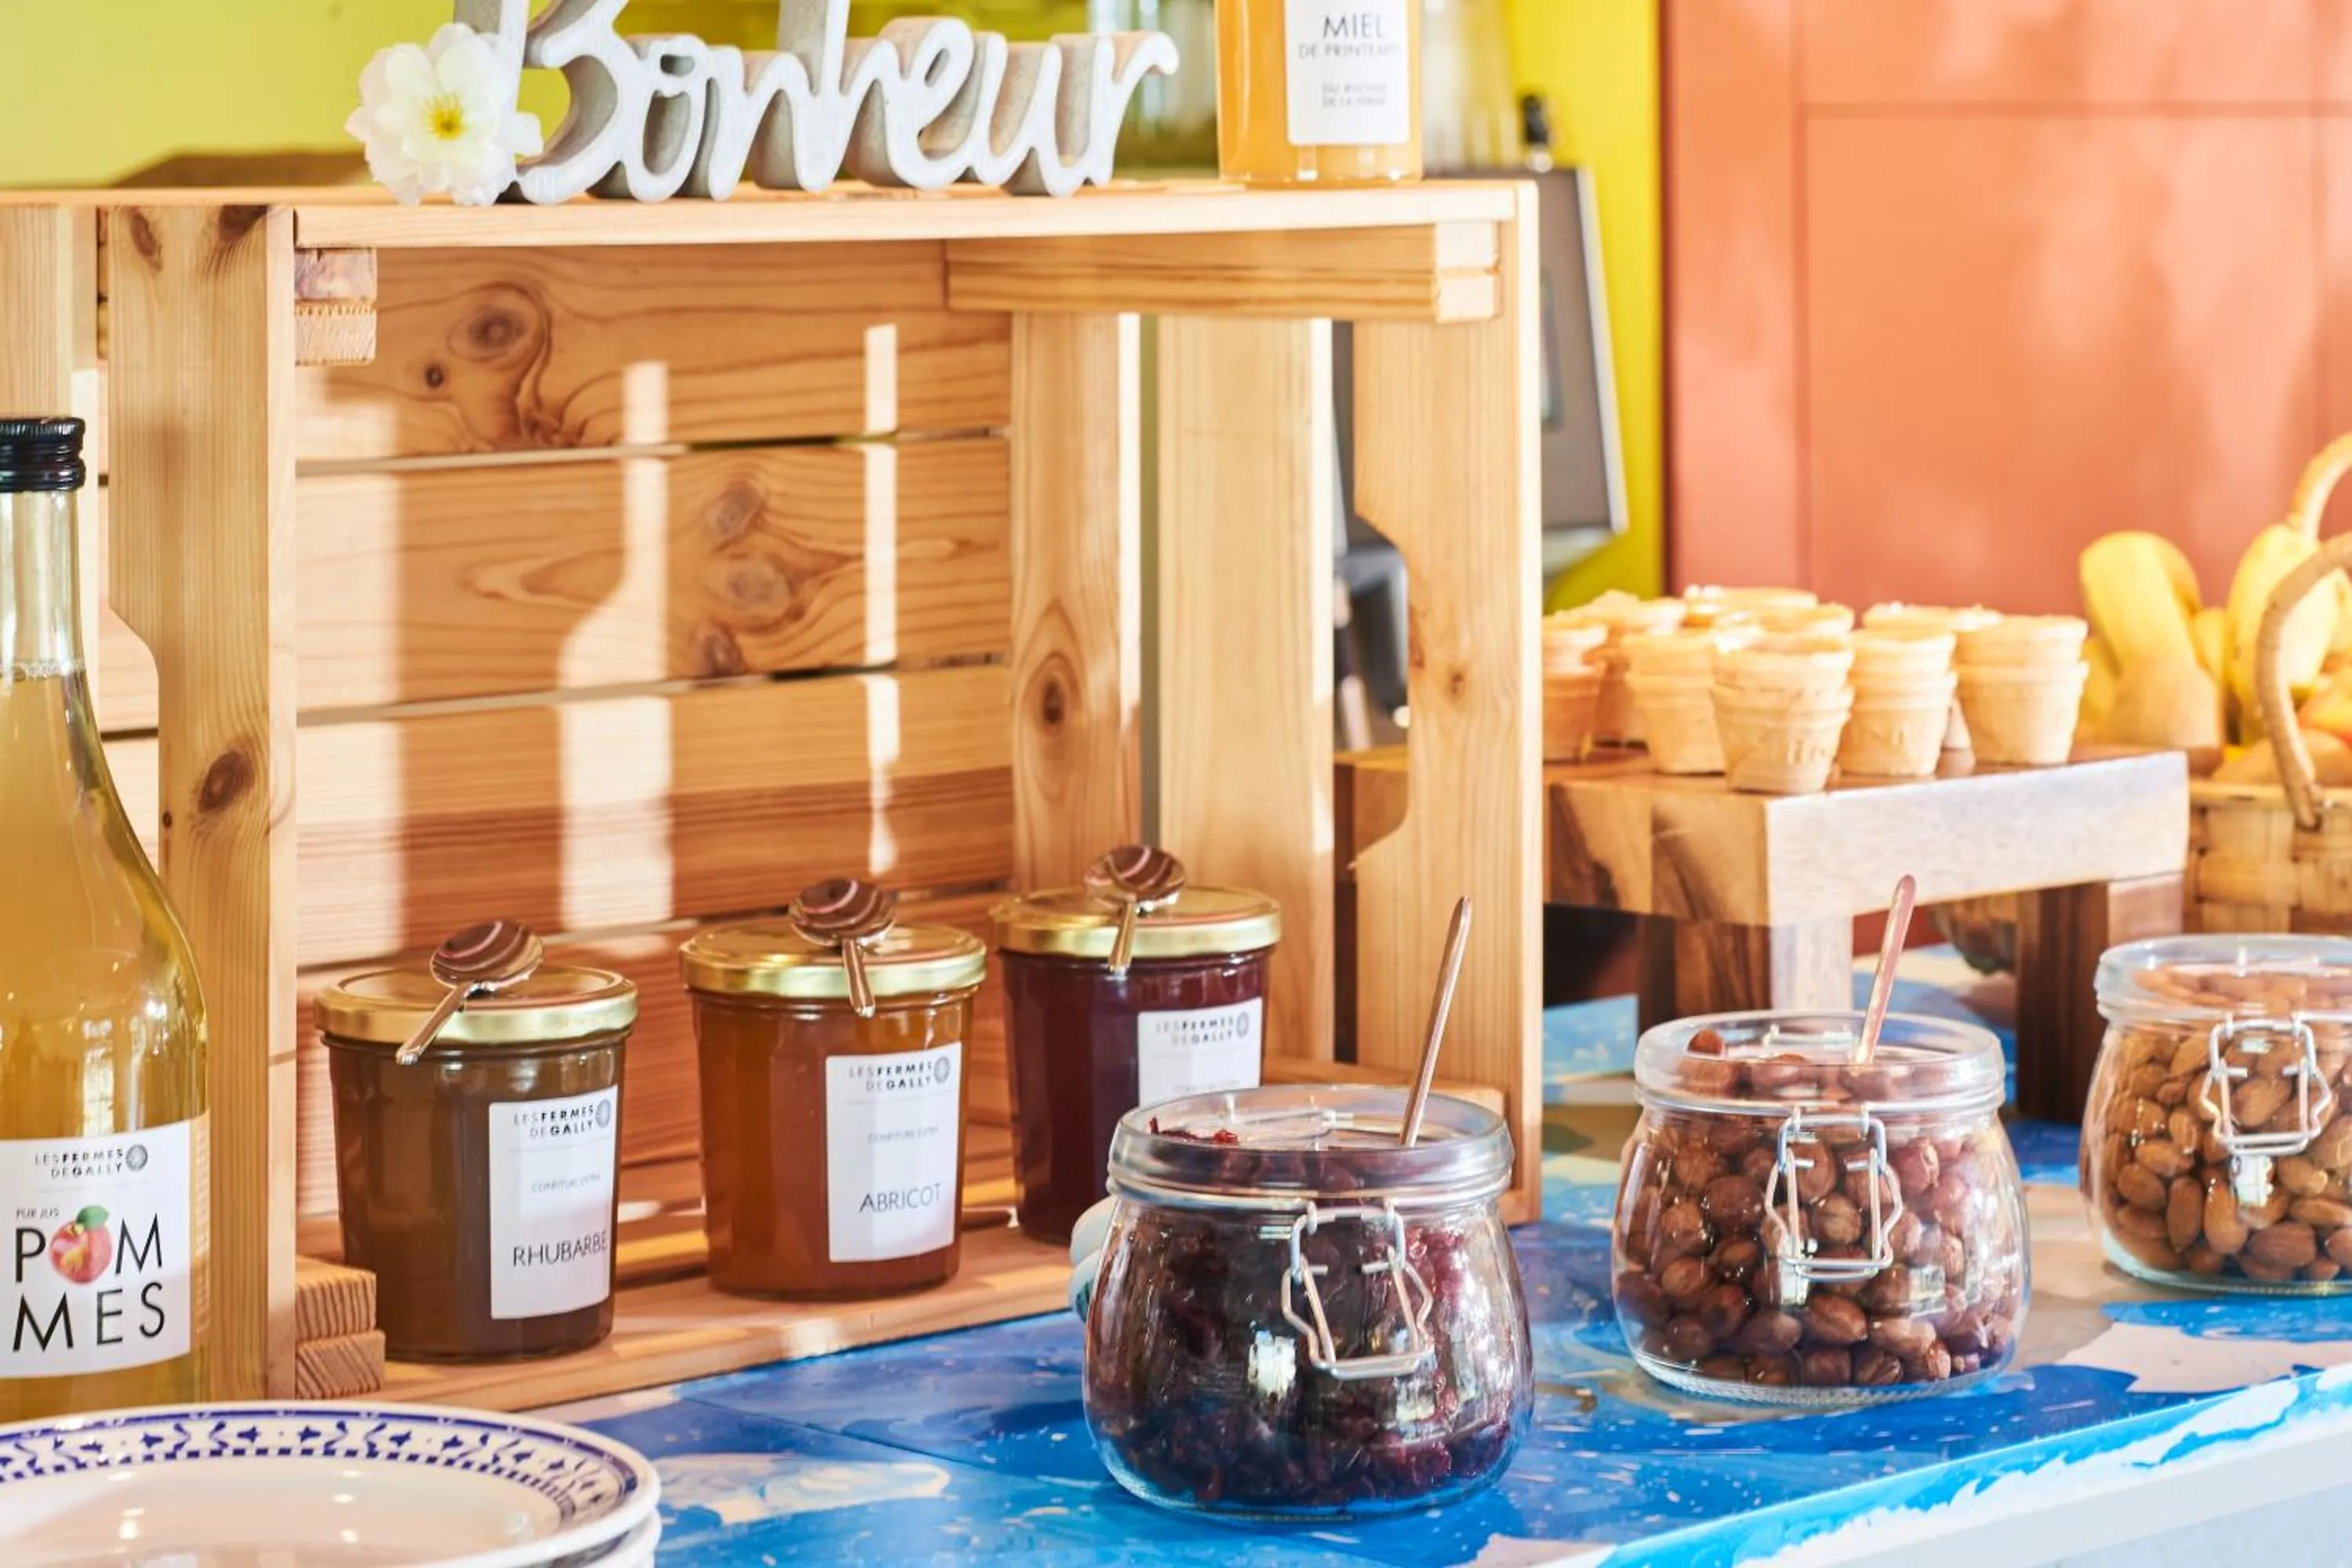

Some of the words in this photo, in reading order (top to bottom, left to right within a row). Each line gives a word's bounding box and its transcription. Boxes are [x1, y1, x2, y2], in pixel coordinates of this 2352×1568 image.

[1323, 13, 1385, 38] MIEL
[1298, 44, 1316, 59] DE
[859, 1182, 942, 1214] ABRICOT
[513, 1229, 609, 1269] RHUBARBE
